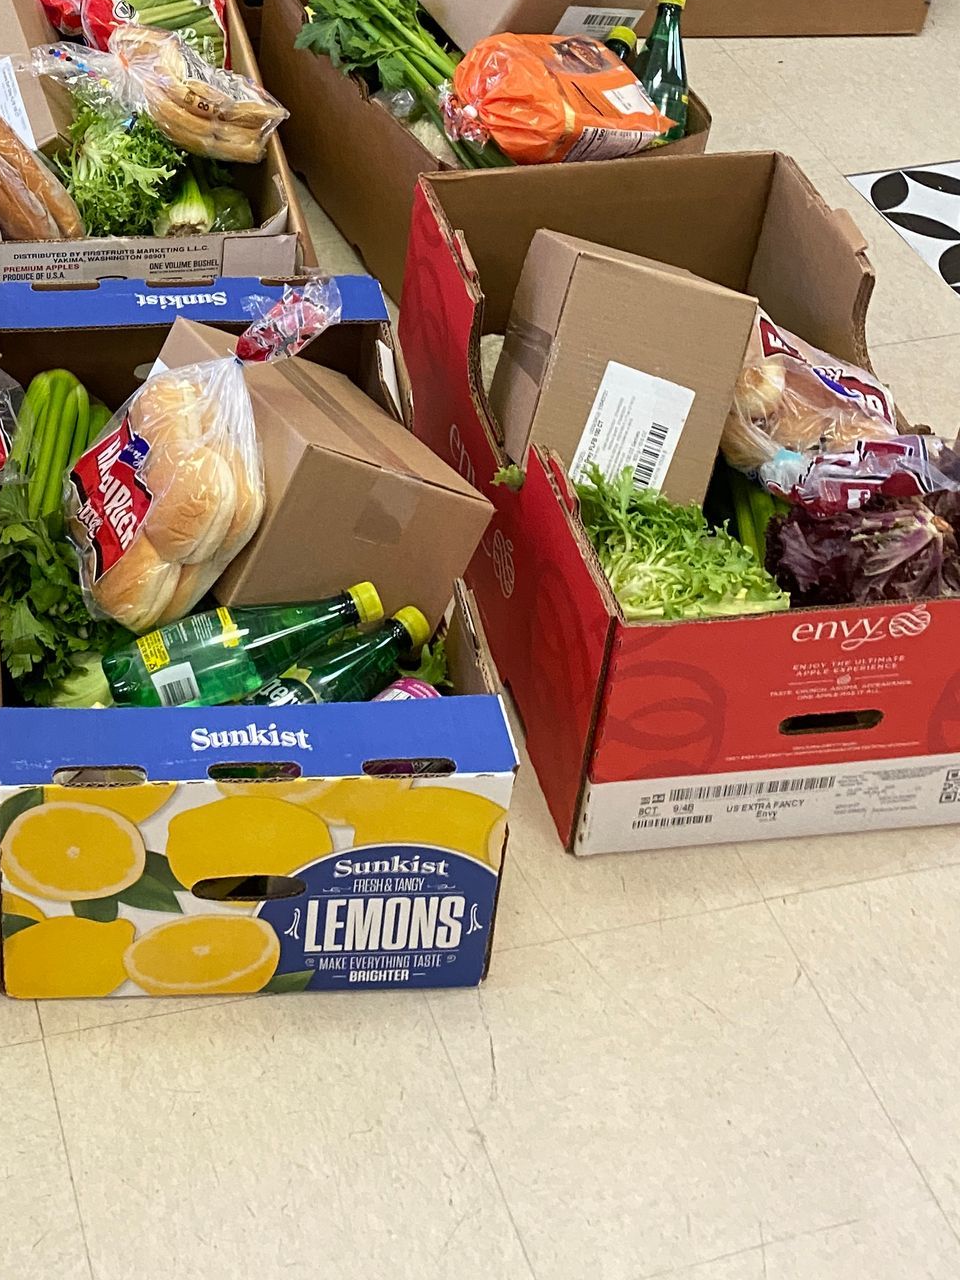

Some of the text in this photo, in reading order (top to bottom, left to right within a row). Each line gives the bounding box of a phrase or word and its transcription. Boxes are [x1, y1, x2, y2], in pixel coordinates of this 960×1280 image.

[13, 251, 68, 260] DISTRIBUTED
[82, 249, 136, 258] FIRSTFRUITS
[137, 246, 186, 255] MARKETING
[53, 253, 167, 265] YAKIMA, WASHINGTON 98901
[3, 259, 220, 273] PREMIUM APPLES ONE VOLUME BUSHEL
[2, 273, 34, 281] PRODUCE
[35, 272, 45, 281] OF
[135, 290, 228, 311] Sunkist
[792, 616, 887, 651] envy
[793, 655, 906, 671] ENJOY THE ULTIMATE
[796, 663, 898, 677] APPLE EXPERIENCE
[190, 722, 313, 753] Sunkist
[741, 801, 772, 811] EXTRA
[774, 799, 805, 809] FANCY
[334, 855, 450, 878] Sunkist
[353, 877, 425, 893] FRESH & TANGY
[304, 895, 466, 953] LEMONS
[319, 953, 442, 971] MAKE EVERYTHING TASTE
[349, 969, 410, 983] BRIGHTER
